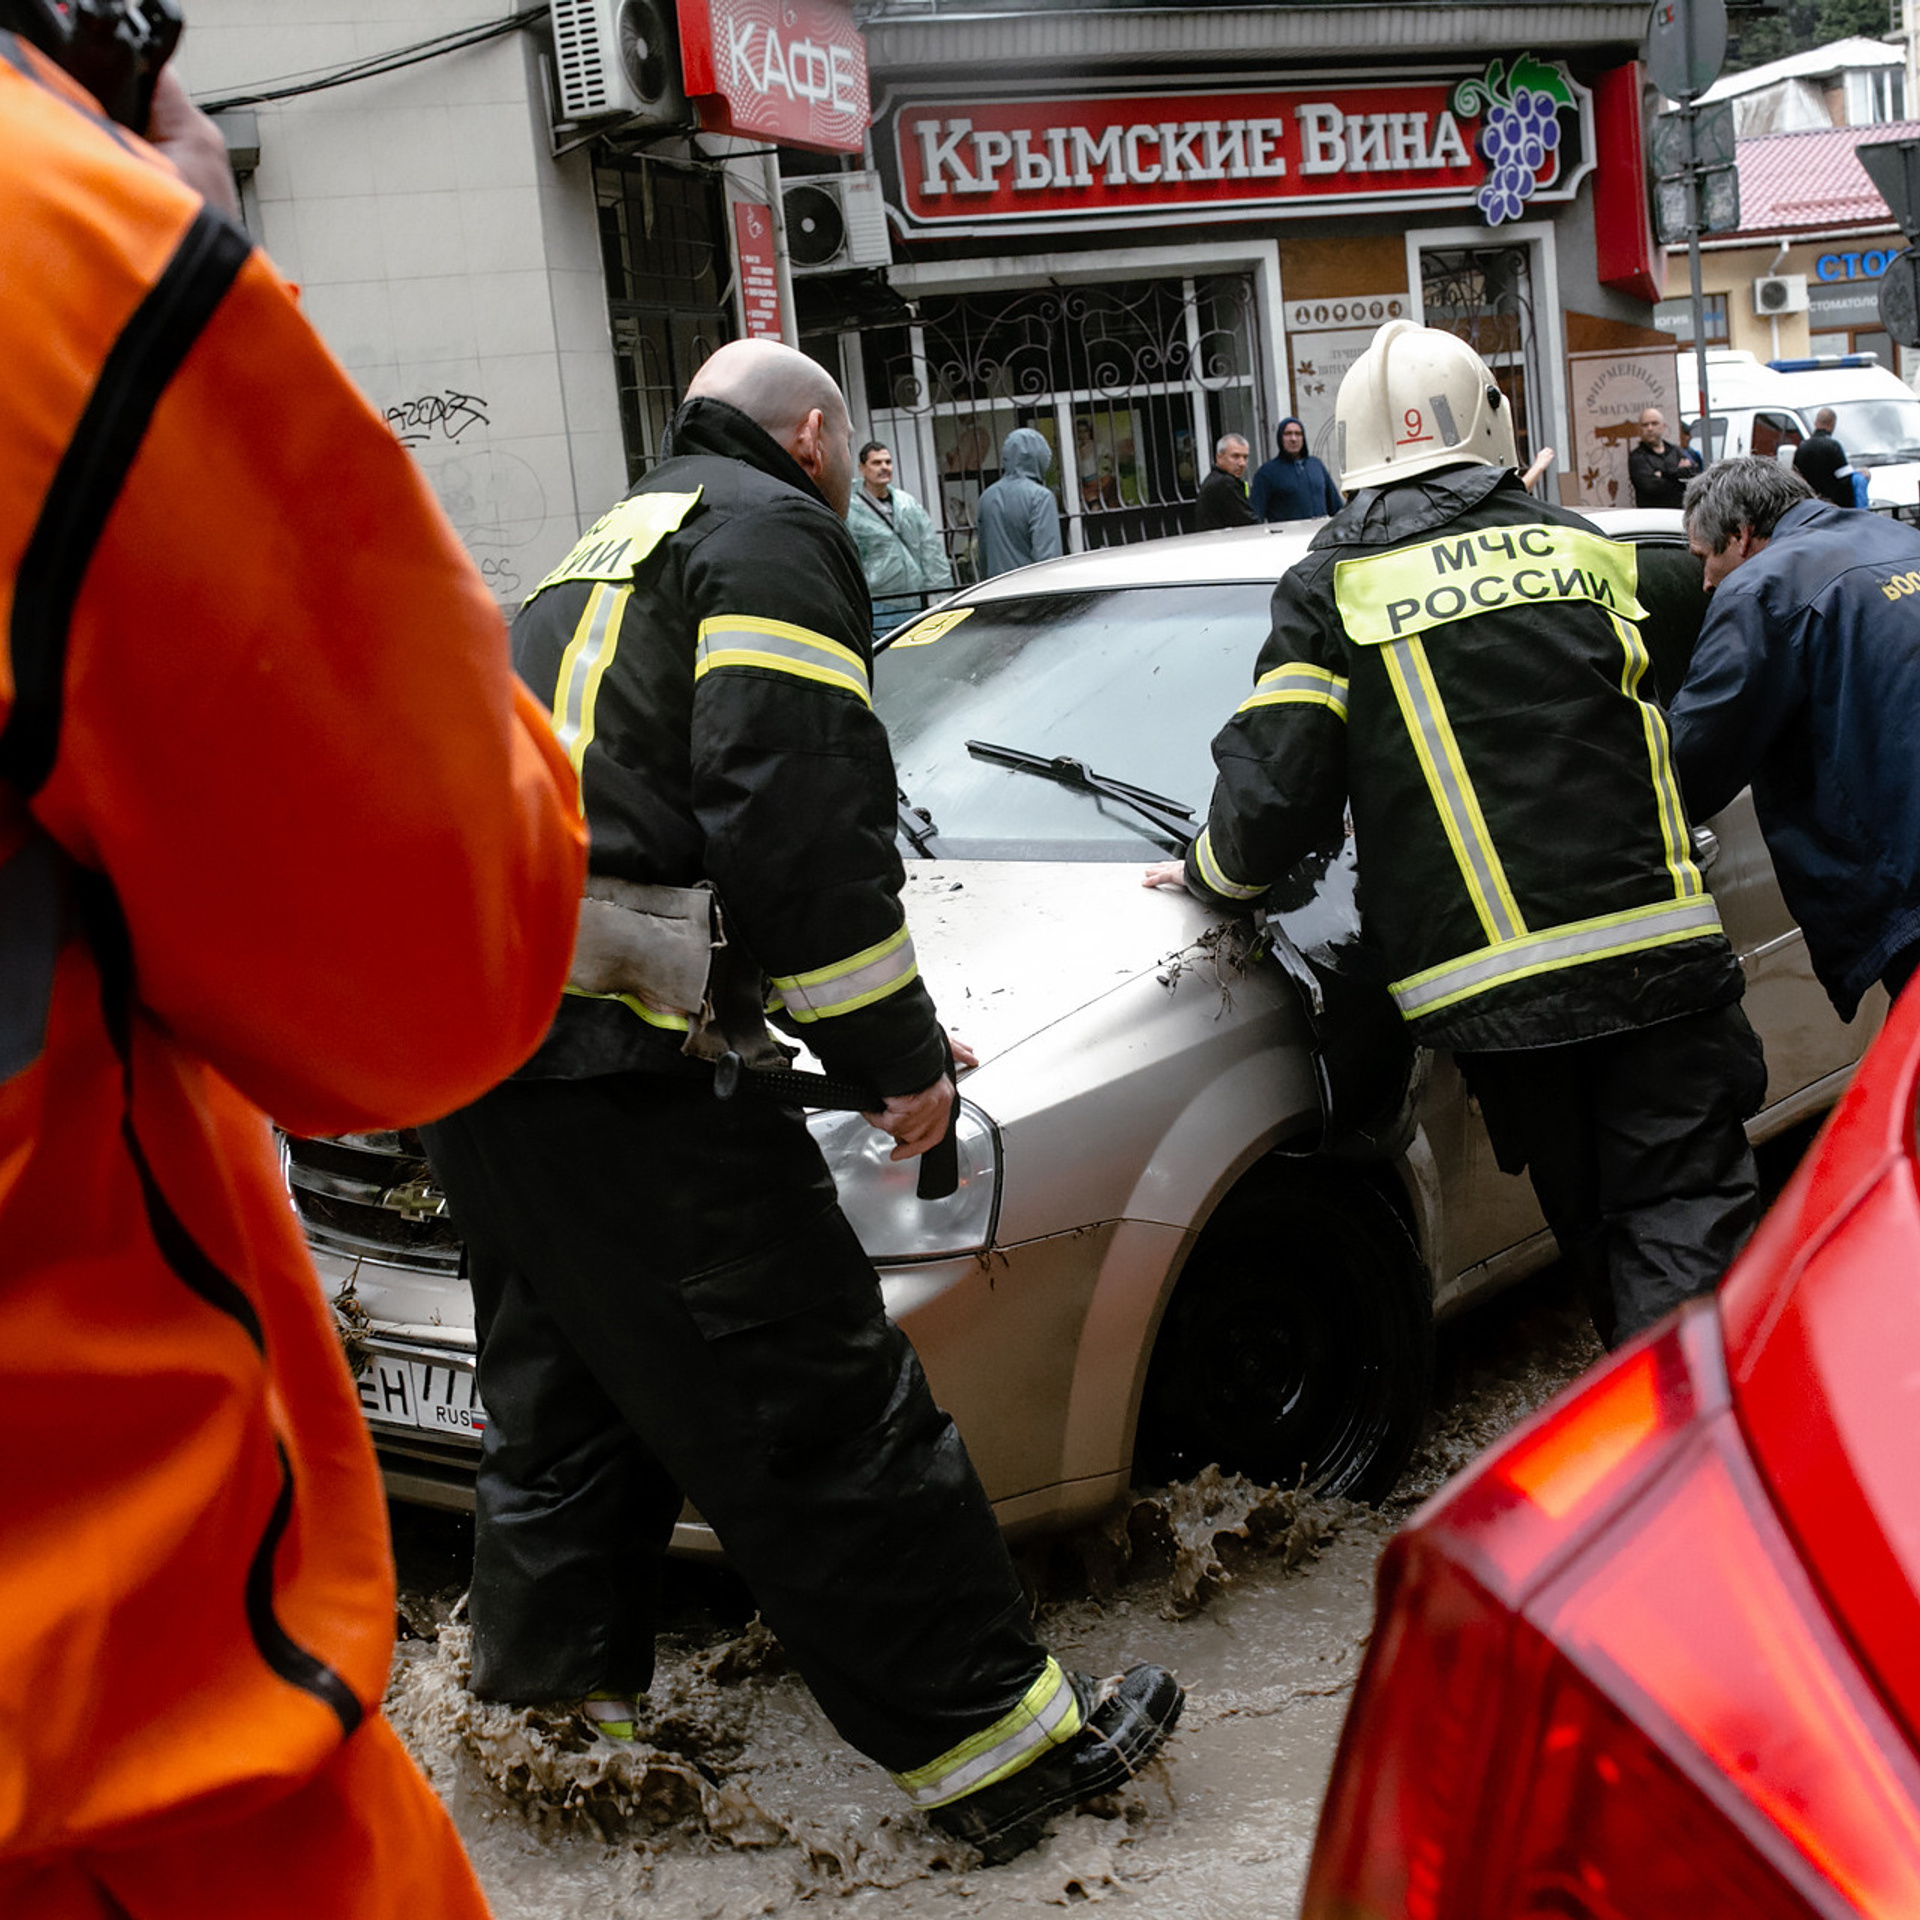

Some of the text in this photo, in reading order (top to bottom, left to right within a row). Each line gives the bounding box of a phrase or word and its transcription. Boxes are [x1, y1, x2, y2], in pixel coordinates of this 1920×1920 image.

[726, 17, 857, 116] КАФЕ
[914, 102, 1472, 196] КРЫМСКИЕ ВИНА
[1404, 408, 1422, 438] 9
[1431, 528, 1555, 575] МЧС
[1386, 567, 1616, 634] РОССИИ
[436, 1405, 470, 1427] RUS
